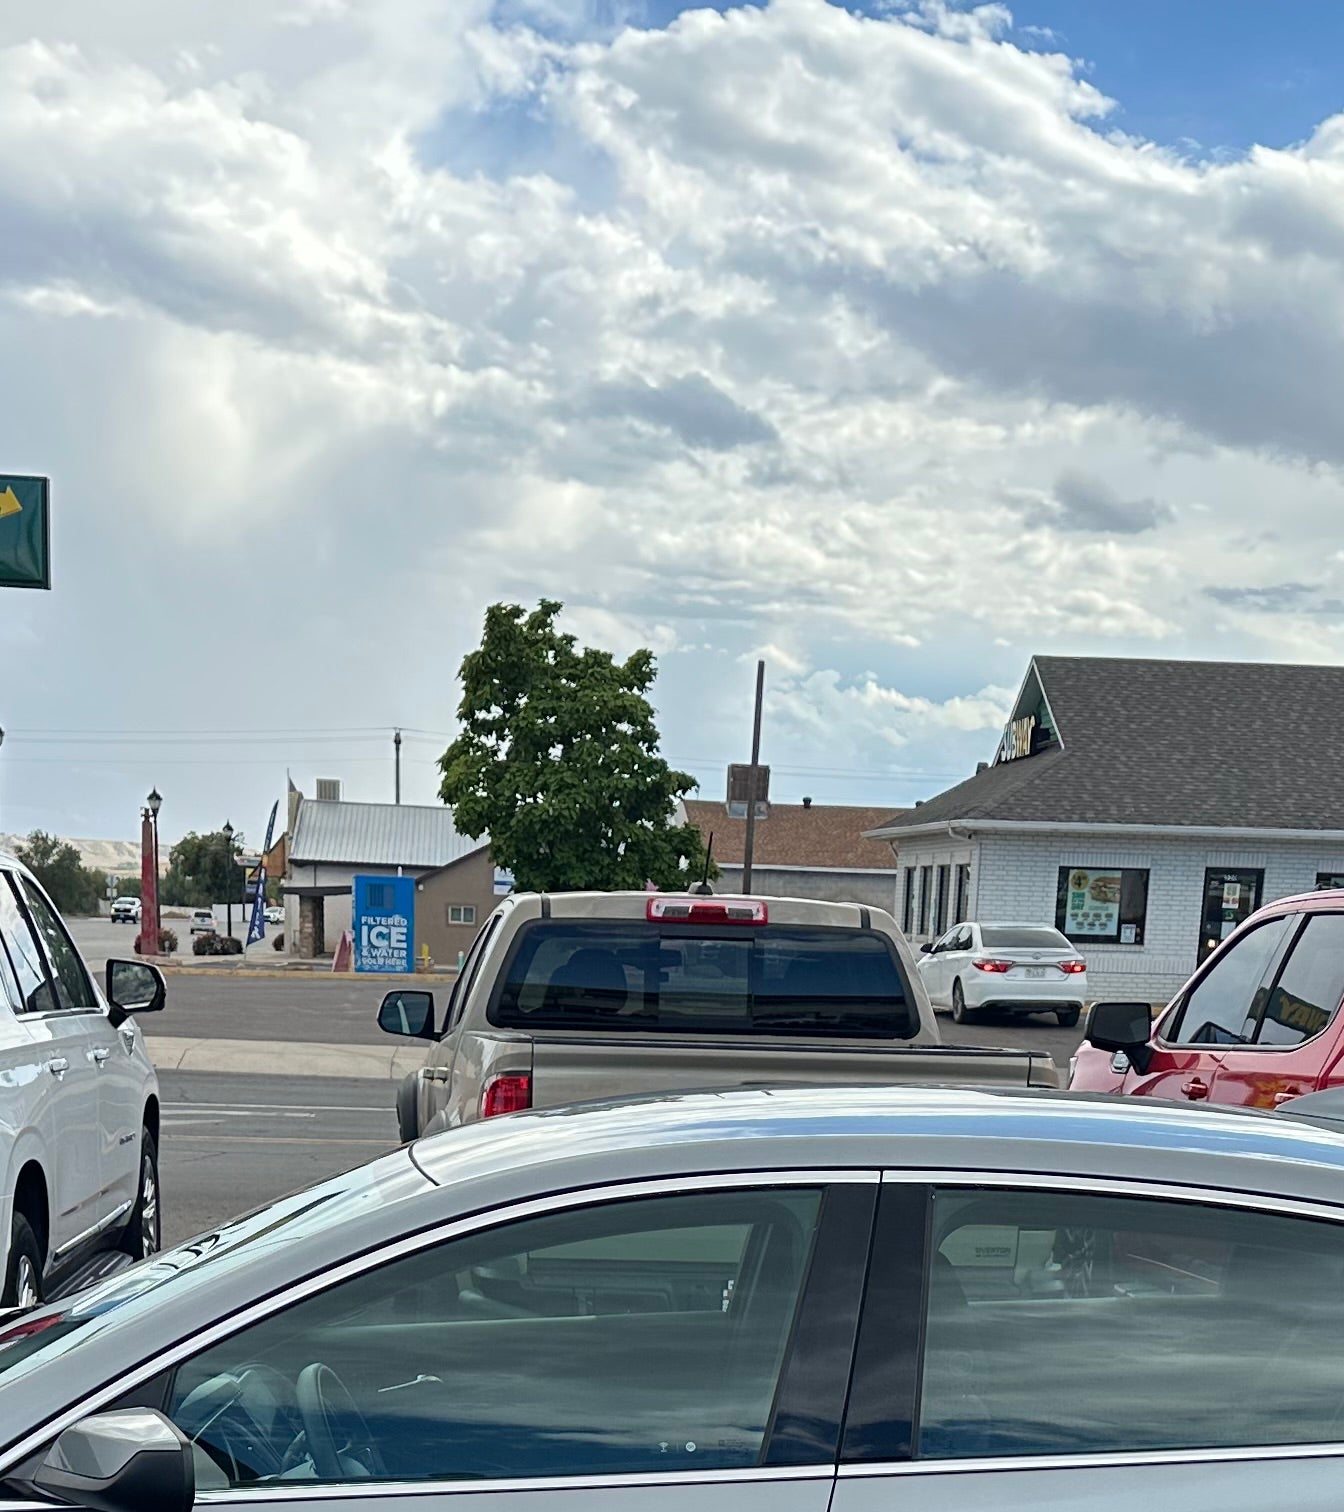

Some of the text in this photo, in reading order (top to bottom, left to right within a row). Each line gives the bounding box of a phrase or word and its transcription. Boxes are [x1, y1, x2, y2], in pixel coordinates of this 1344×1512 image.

[361, 916, 408, 926] FILTERED
[361, 925, 408, 949] ICE
[371, 948, 407, 958] WATER
[385, 958, 408, 967] HERE
